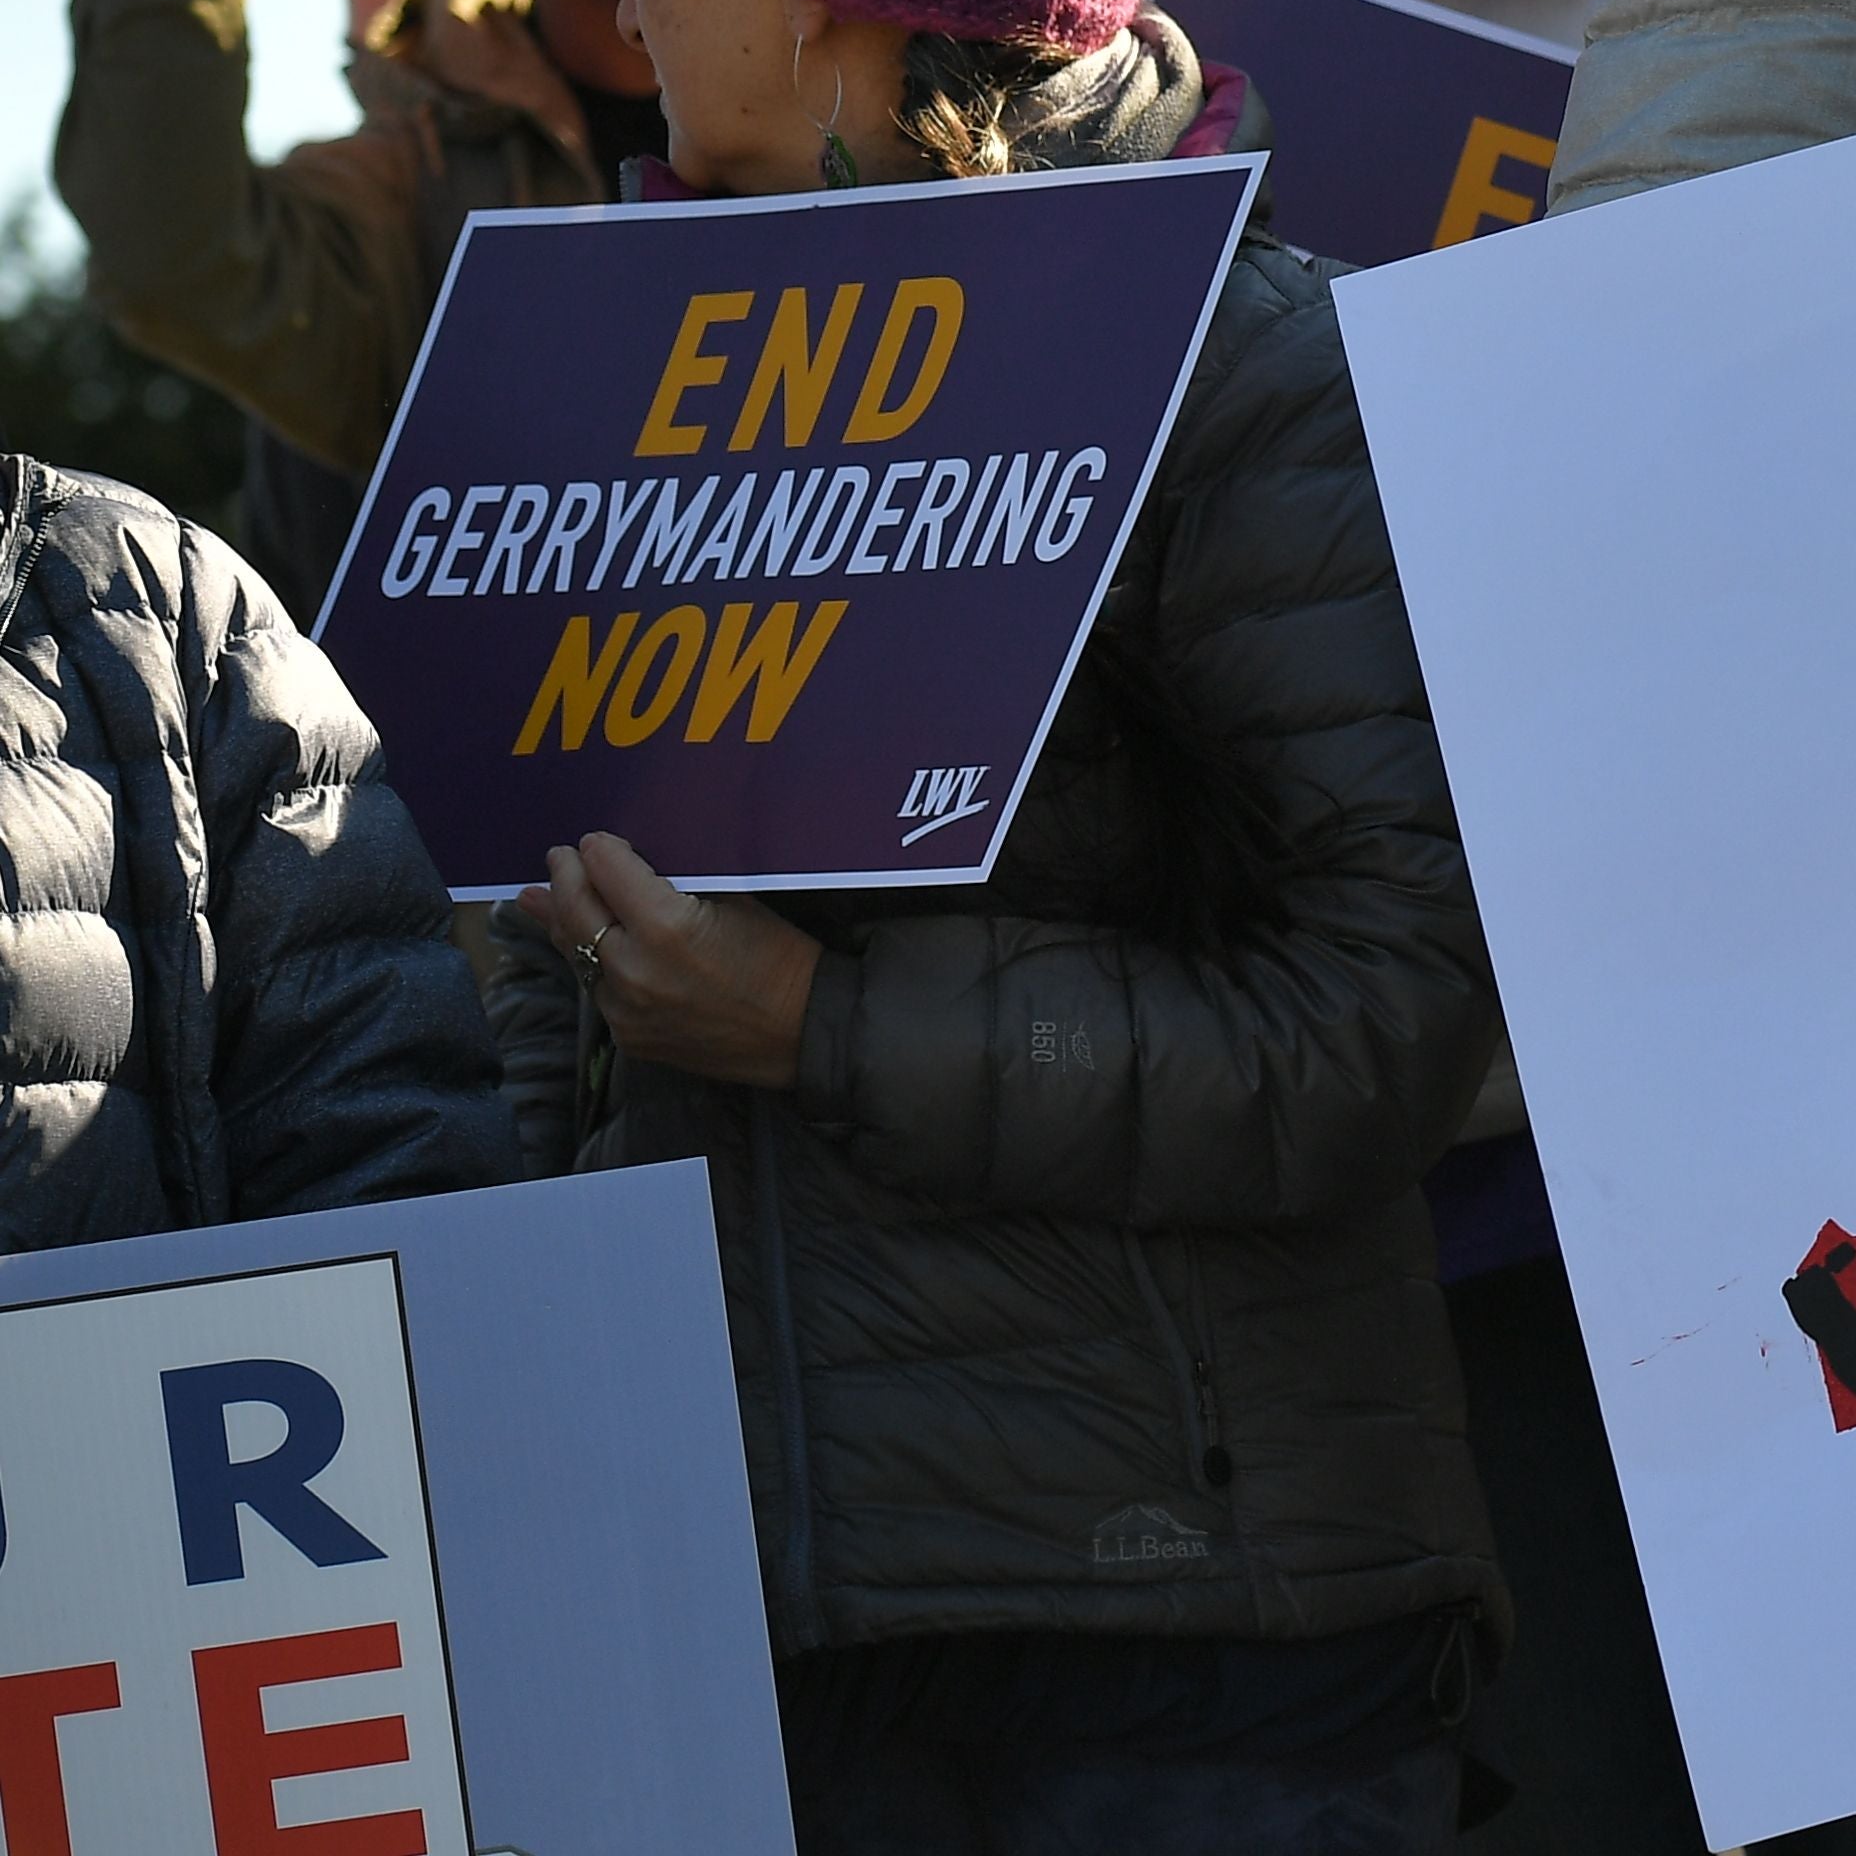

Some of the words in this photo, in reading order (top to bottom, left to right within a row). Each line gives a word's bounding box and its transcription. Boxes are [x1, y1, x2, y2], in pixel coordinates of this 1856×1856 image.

[633, 276, 966, 458] END
[380, 445, 1108, 600] GERRYMANDERING
[511, 600, 851, 757] NOW
[896, 765, 991, 818] LWV
[1031, 1021, 1057, 1063] 850
[1092, 1535, 1209, 1563] L.L.Bean
